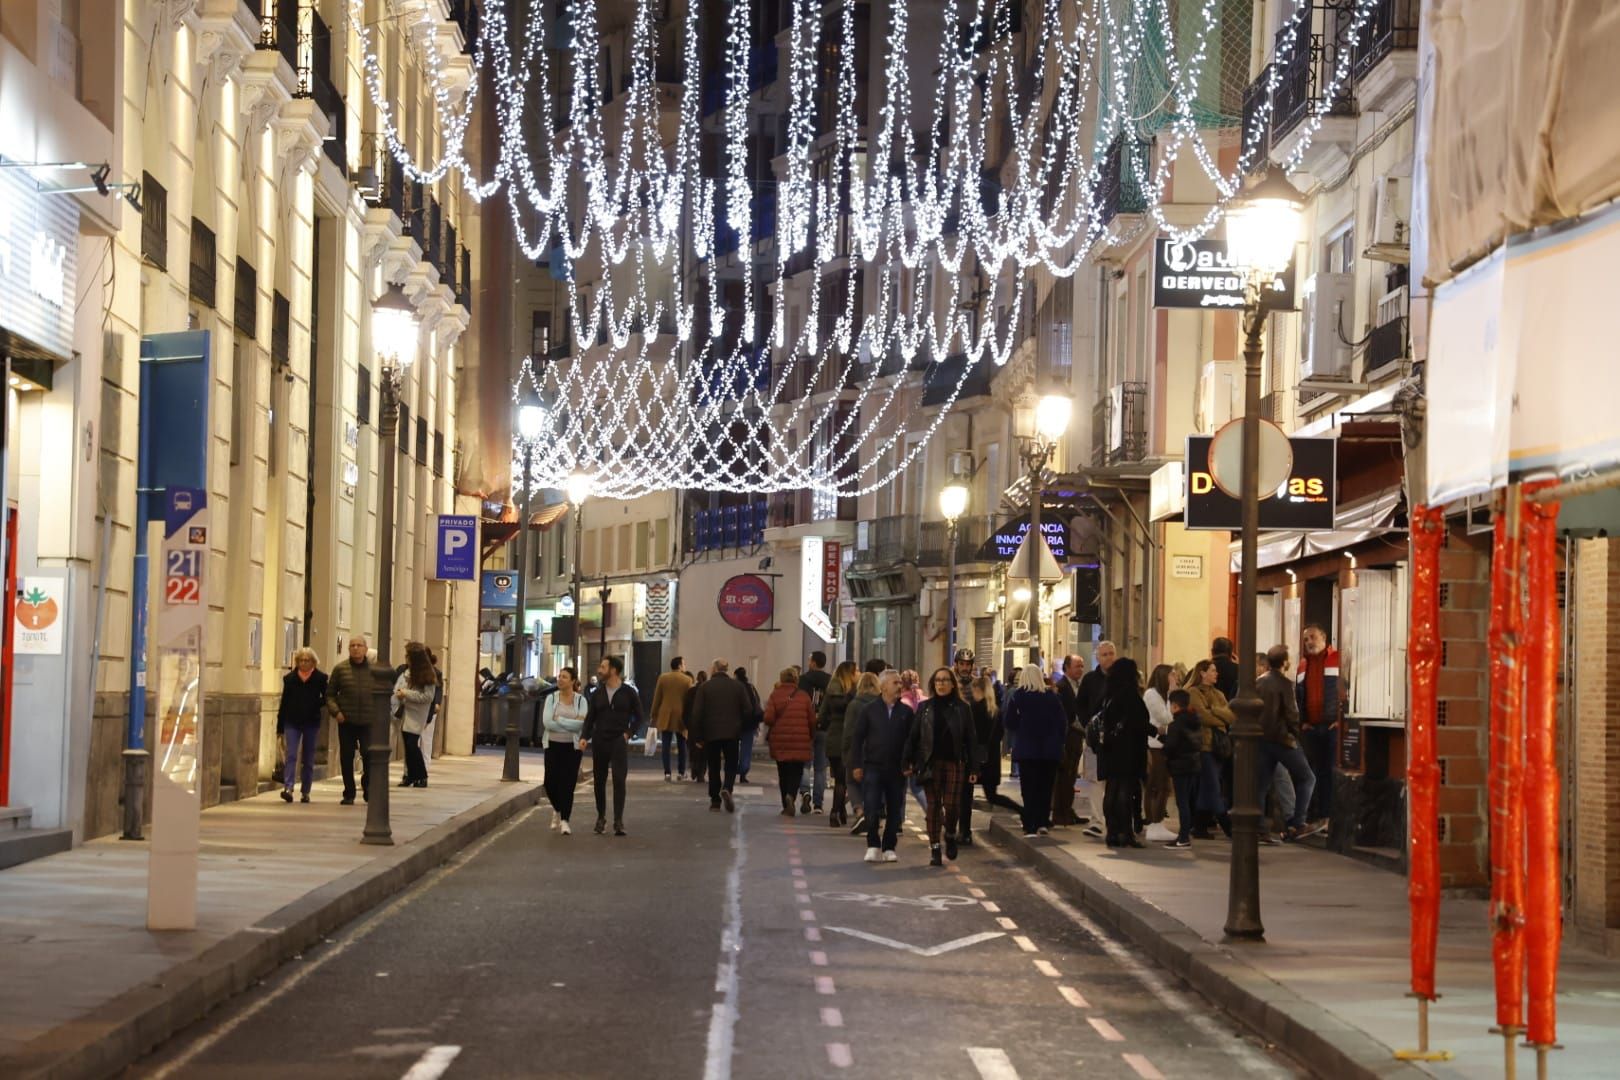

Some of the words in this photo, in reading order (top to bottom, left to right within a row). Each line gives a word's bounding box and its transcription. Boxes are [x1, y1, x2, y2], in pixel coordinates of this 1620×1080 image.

[1018, 523, 1064, 532] ANCIA
[444, 529, 468, 555] P
[995, 535, 1064, 545] INMORIA
[169, 550, 197, 576] 21
[827, 544, 837, 566] SEX
[167, 577, 199, 604] 22
[725, 594, 736, 604] SEX
[741, 594, 758, 604] SHOP
